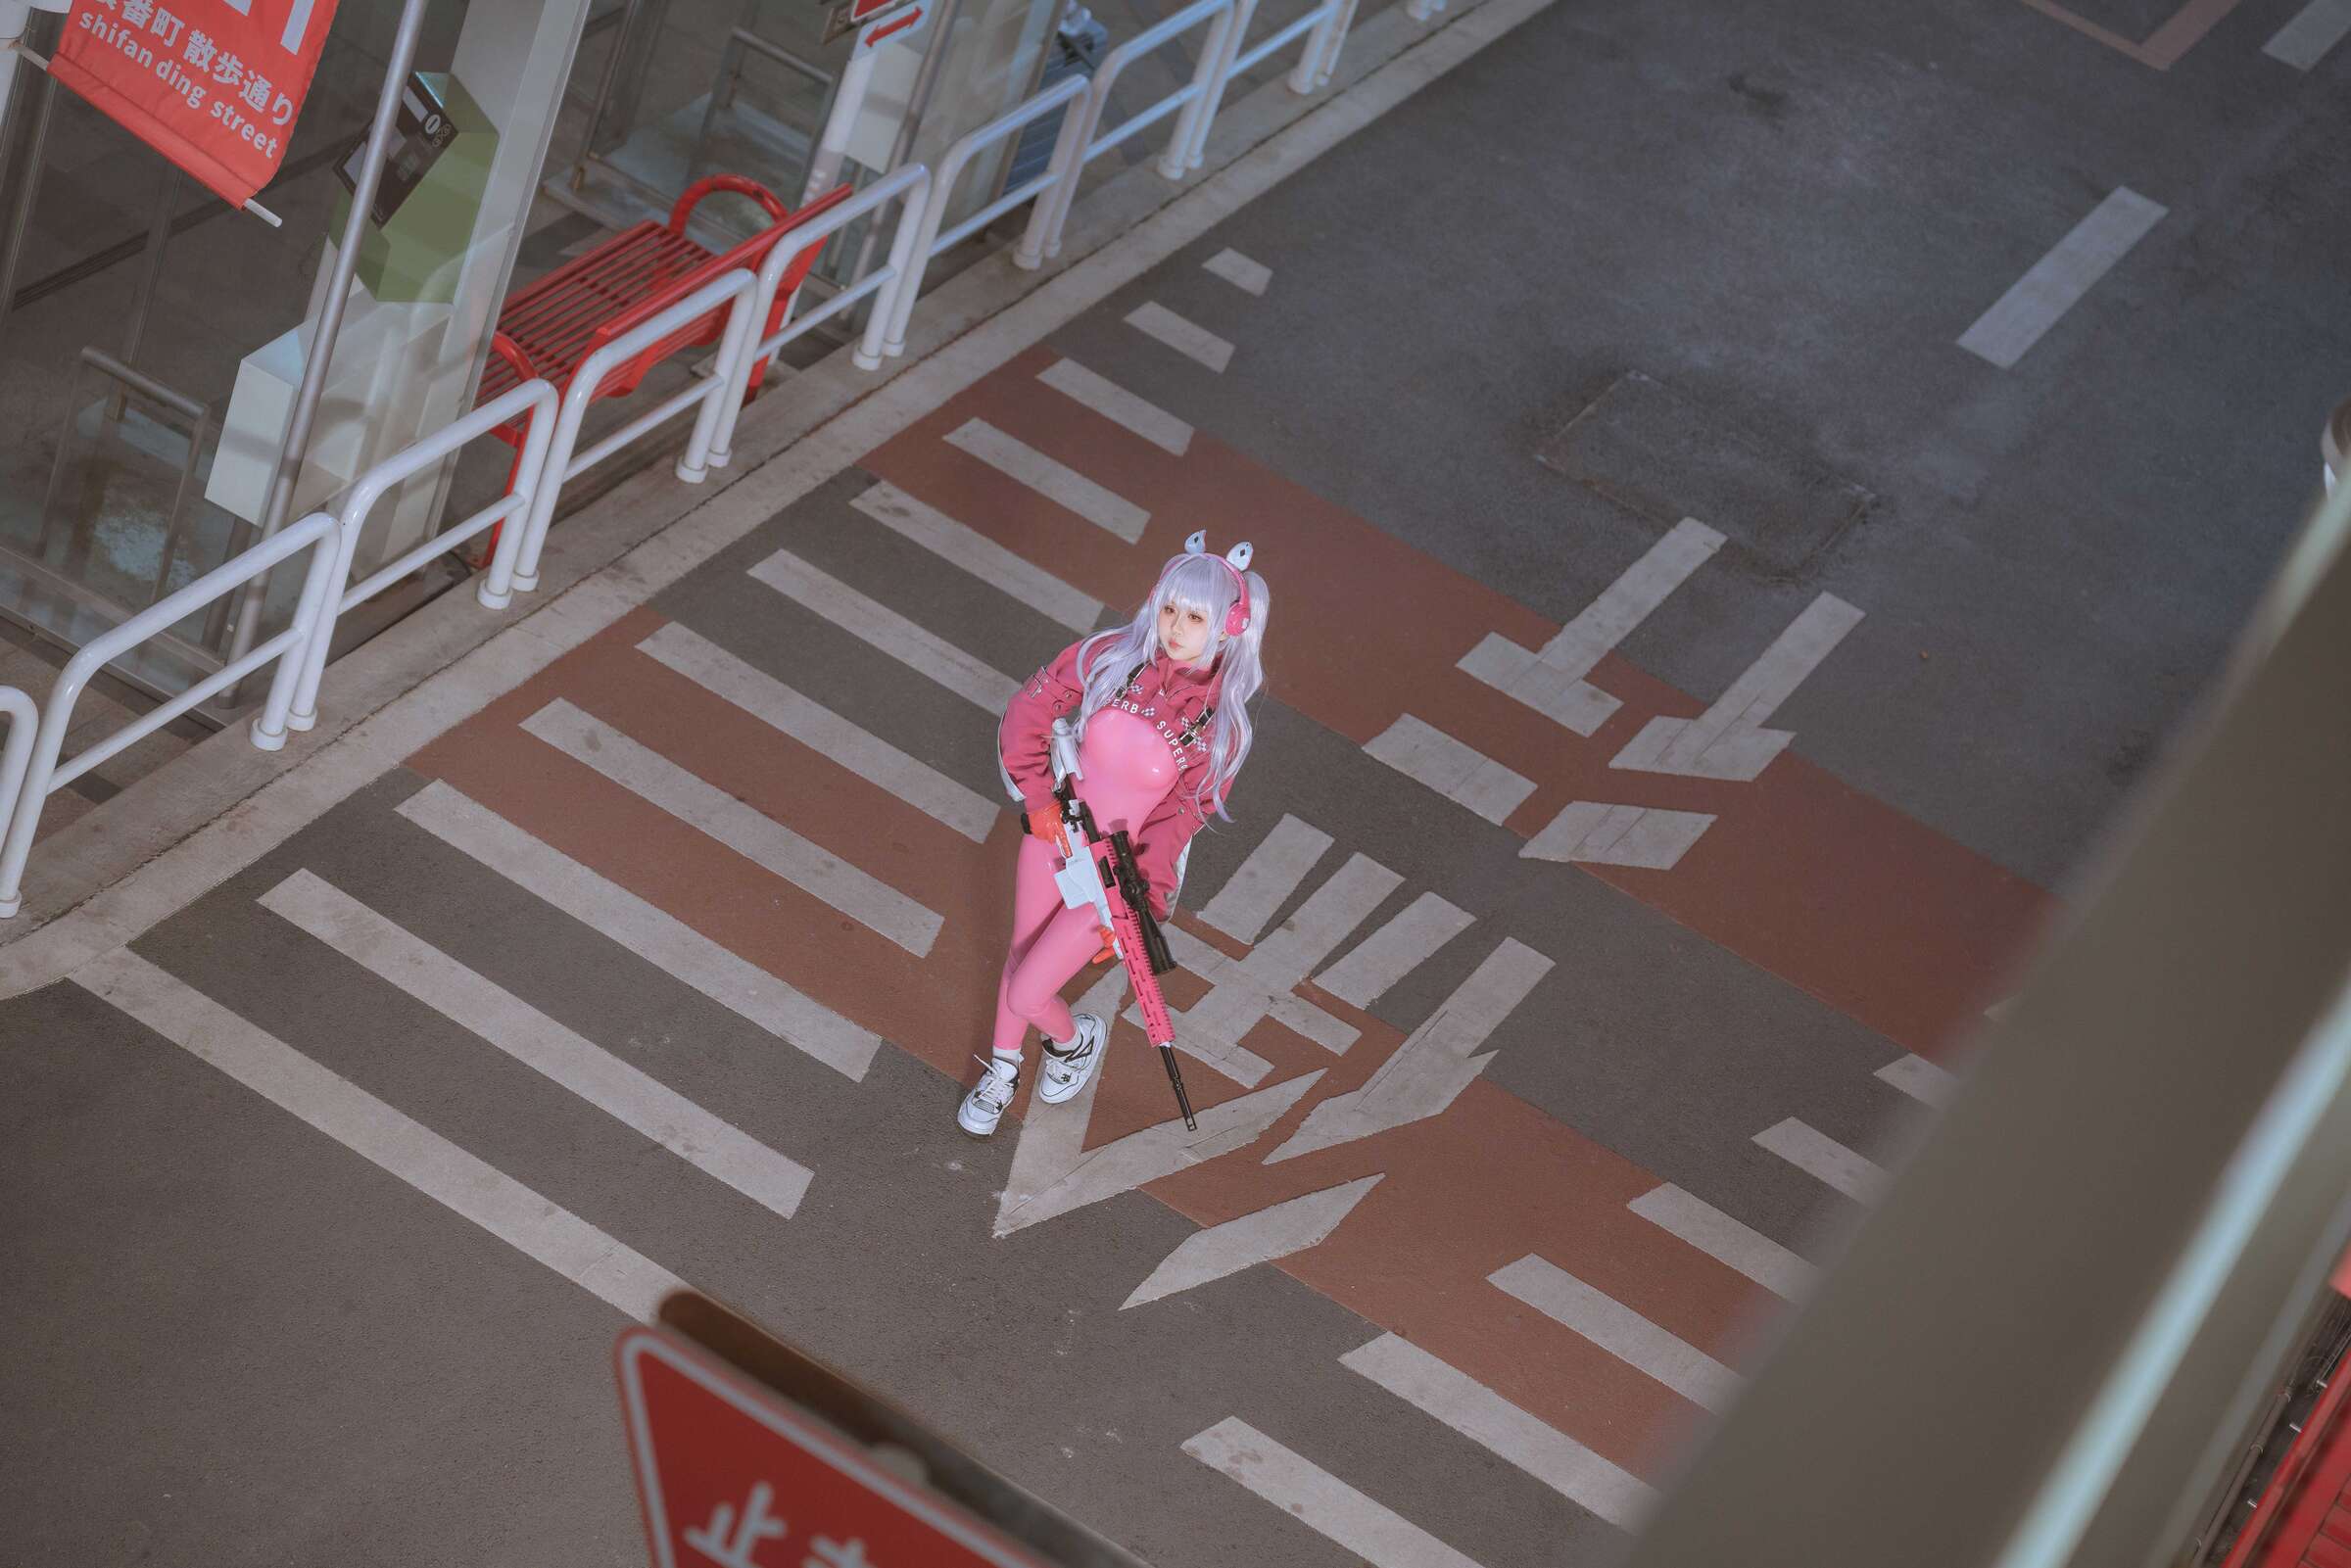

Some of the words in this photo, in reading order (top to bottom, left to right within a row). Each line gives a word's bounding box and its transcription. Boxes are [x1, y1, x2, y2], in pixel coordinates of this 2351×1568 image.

[79, 12, 153, 69] shifan
[157, 59, 206, 109] ding
[210, 101, 277, 158] street
[95, 0, 185, 47] 番町
[183, 29, 293, 125] 散歩通り
